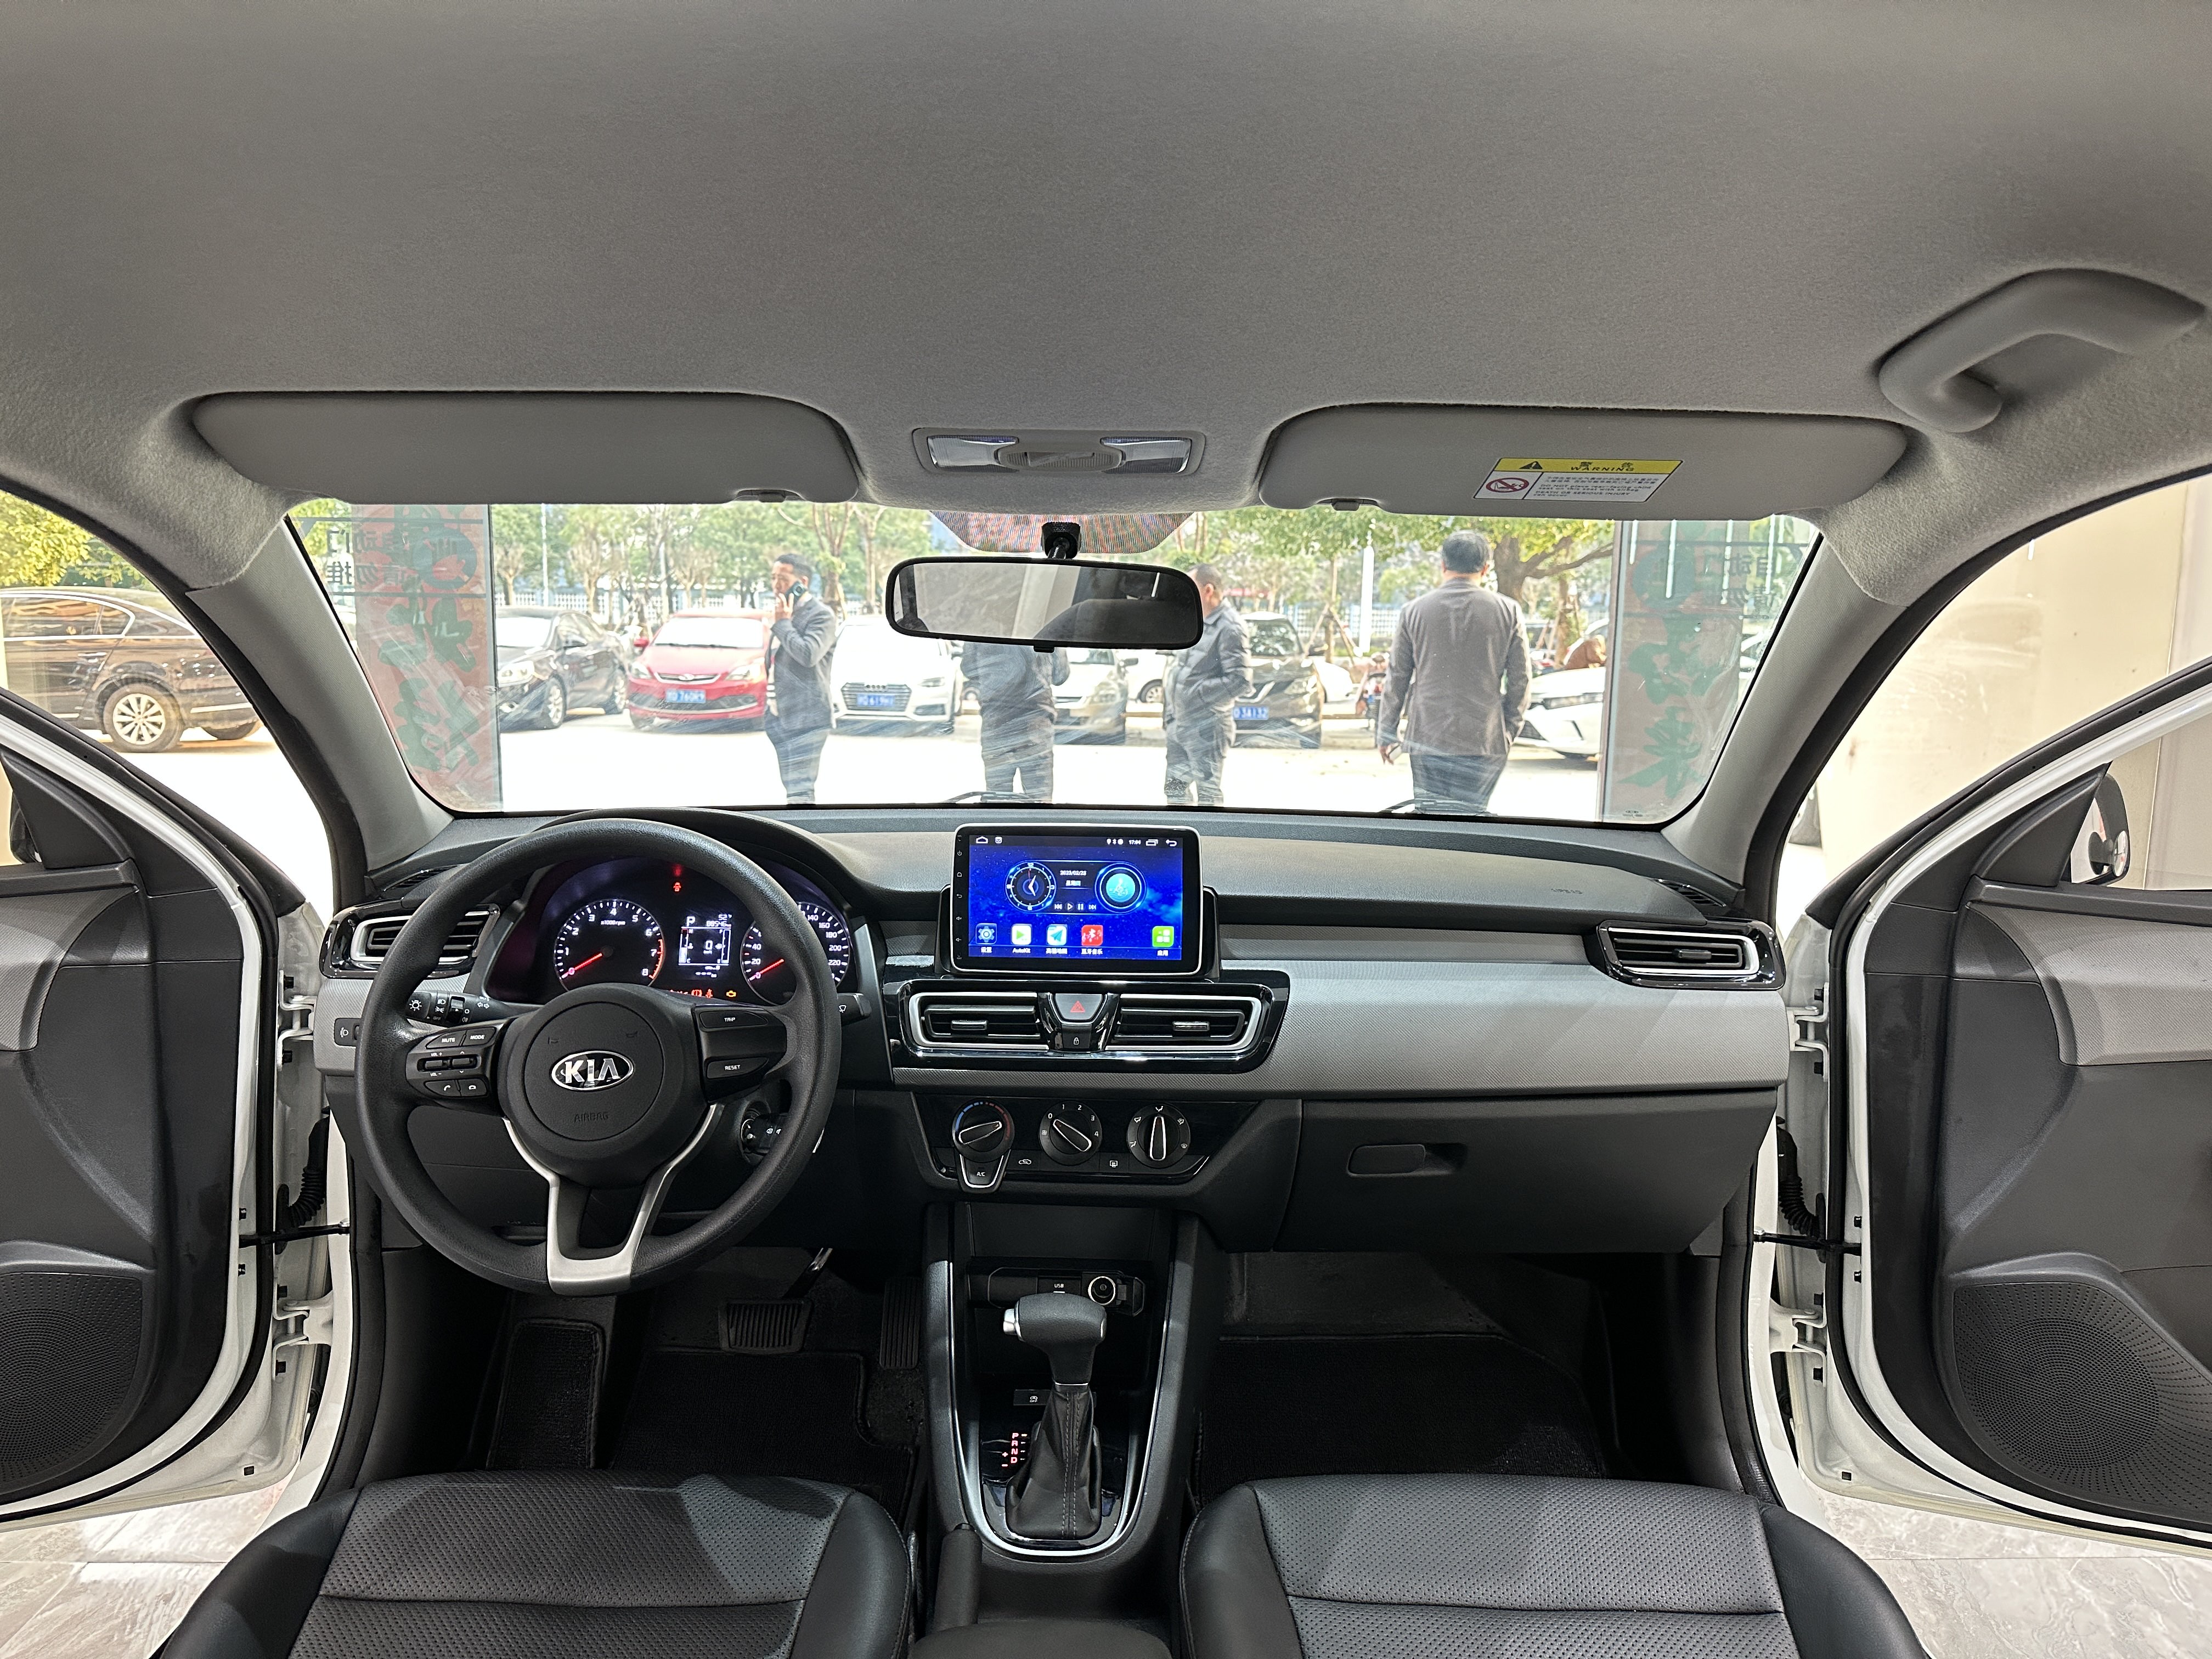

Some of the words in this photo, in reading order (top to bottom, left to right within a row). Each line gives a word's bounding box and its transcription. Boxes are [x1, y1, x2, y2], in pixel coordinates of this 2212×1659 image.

[687, 916, 696, 927] P
[565, 947, 569, 956] 1
[565, 1058, 621, 1084] KIA
[574, 1111, 610, 1124] AIRBAG
